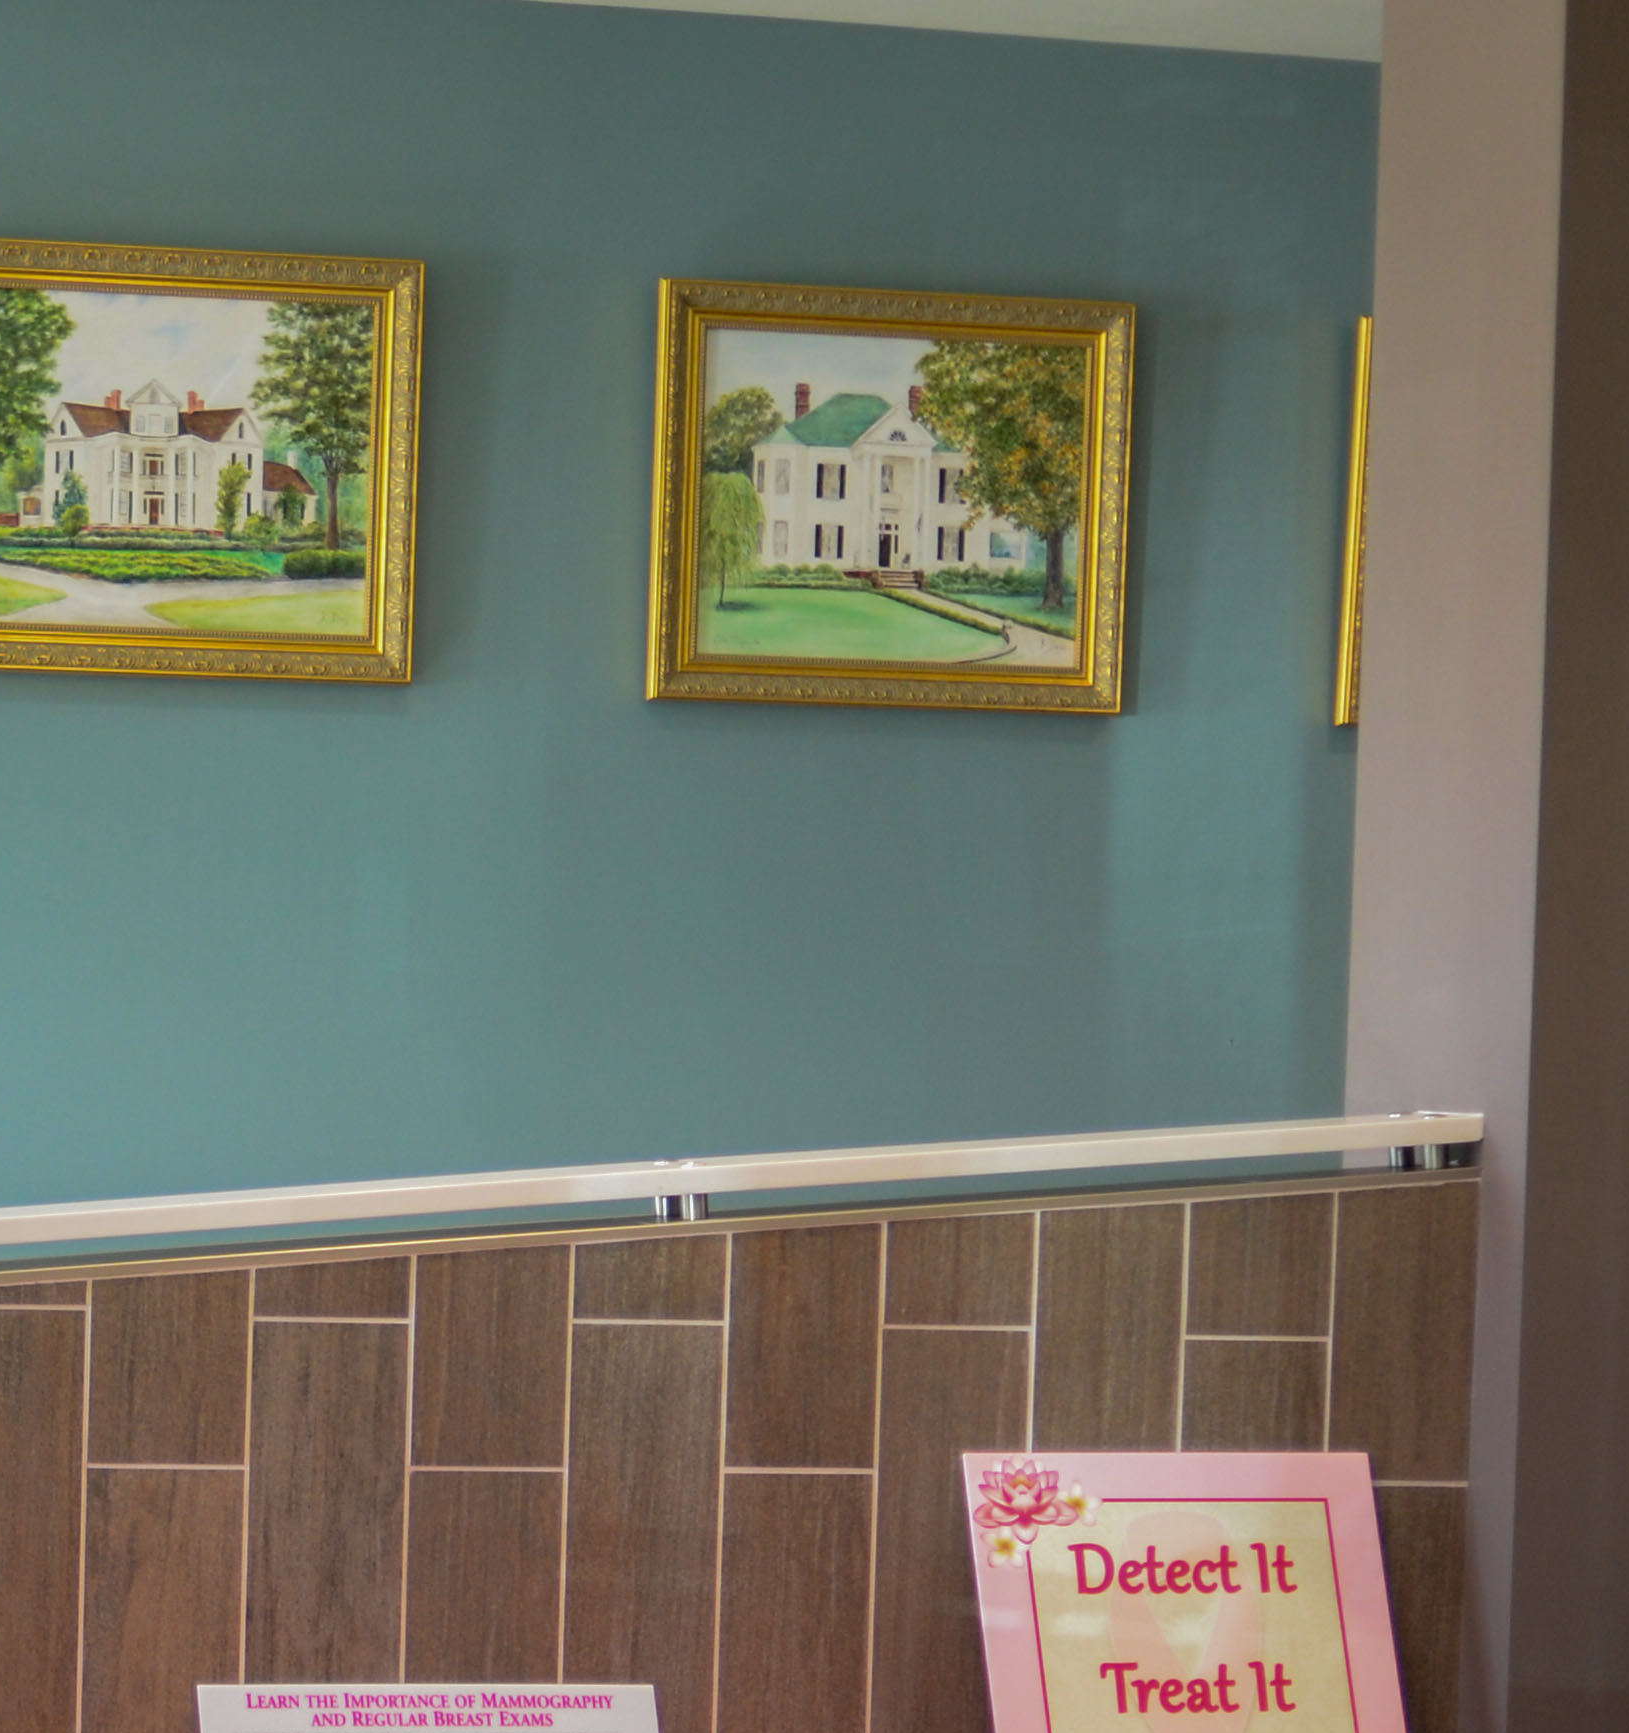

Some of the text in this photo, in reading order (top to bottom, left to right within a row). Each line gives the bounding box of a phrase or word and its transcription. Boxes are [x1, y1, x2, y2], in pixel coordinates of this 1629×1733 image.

[1067, 1542, 1298, 1595] Detect It
[246, 1692, 613, 1709] LEARN THE IMPORTANCE OF MAMMOGRAPHY
[1100, 1661, 1296, 1714] Treat It
[312, 1711, 554, 1727] AND REGULAR BREAST EXAMS
